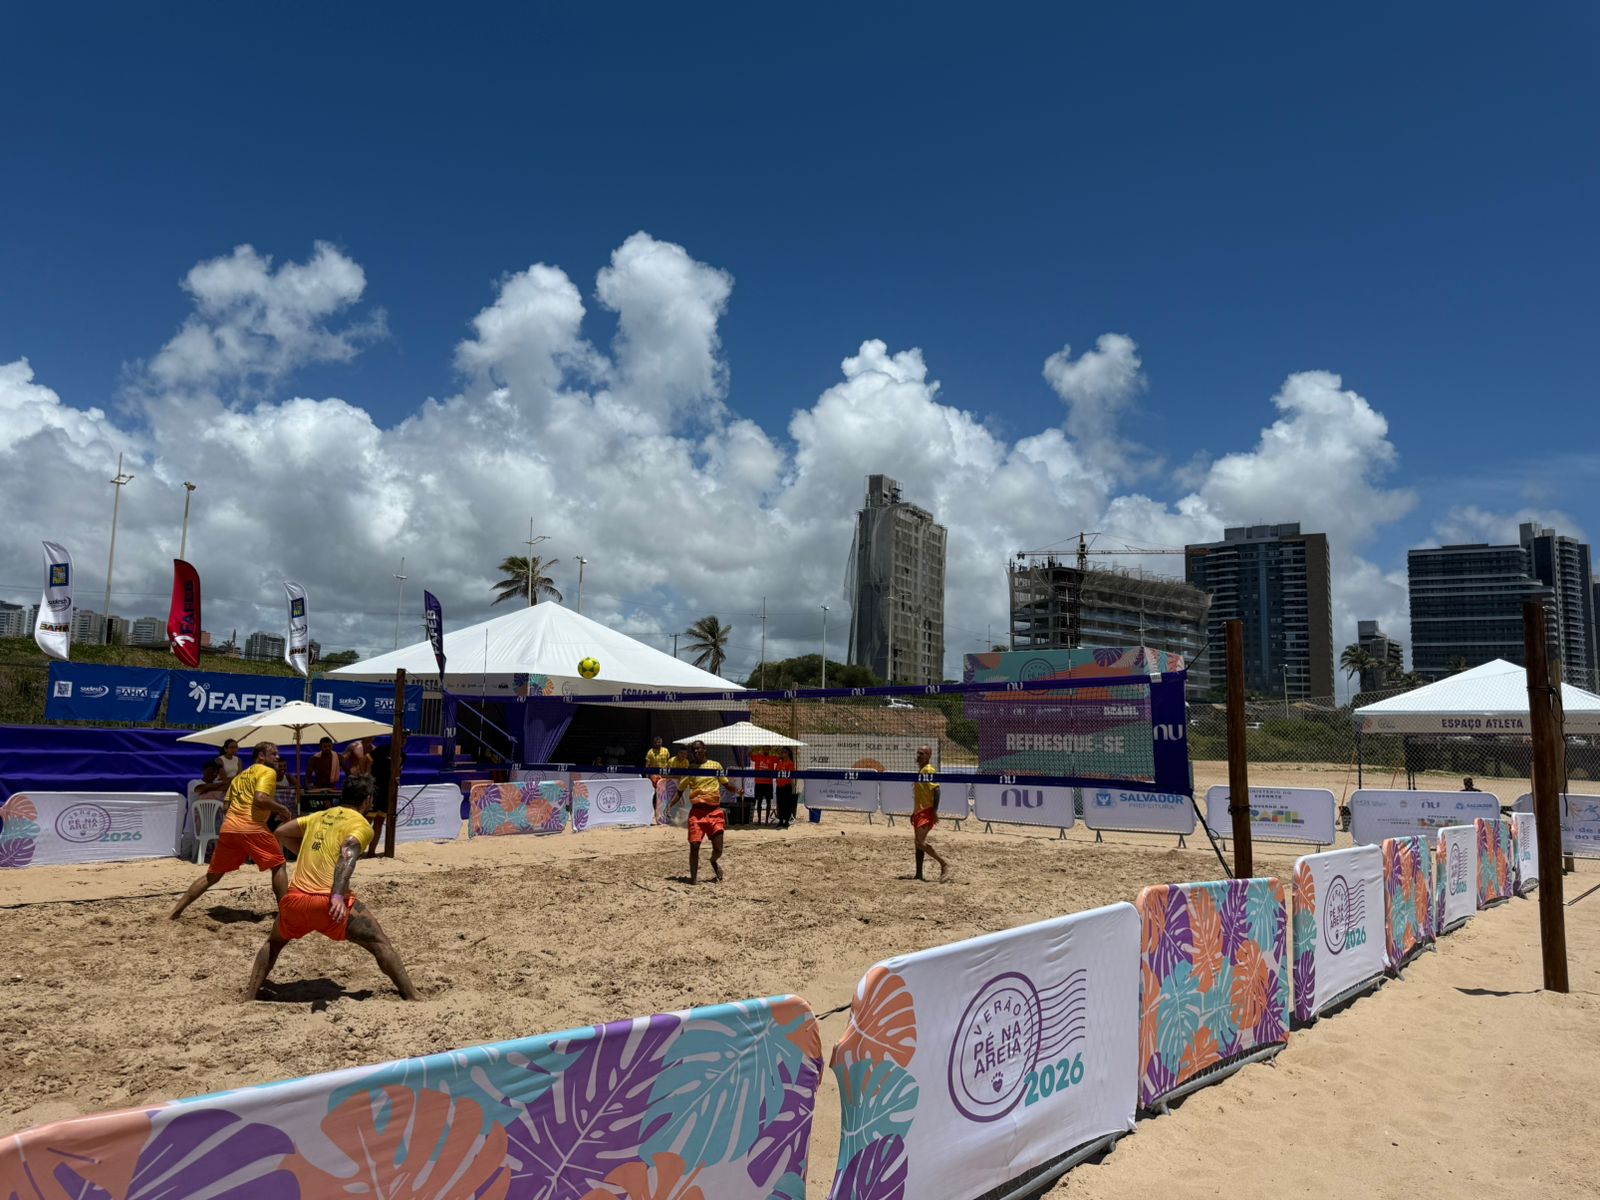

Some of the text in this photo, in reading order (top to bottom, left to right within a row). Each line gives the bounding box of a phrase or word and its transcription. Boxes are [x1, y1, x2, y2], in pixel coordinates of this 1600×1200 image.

[427, 609, 440, 654] FAFEB
[208, 691, 287, 712] FAFEB
[1153, 724, 1184, 741] nu
[1441, 718, 1524, 731] ESPAÇO ATLETA
[1005, 733, 1125, 754] REFRESQUE-SE
[616, 805, 637, 813] 2026
[1001, 788, 1044, 809] nu
[1119, 793, 1185, 805] SALVADOR
[1421, 801, 1440, 809] nu
[406, 817, 436, 827] 2026
[99, 831, 142, 842] 2026
[1345, 925, 1367, 951] 2026
[973, 996, 1022, 1036] VERÃO
[974, 1020, 1022, 1061] PÉ NA
[974, 1038, 1022, 1079] AREIA
[1024, 1052, 1085, 1107] 2026
